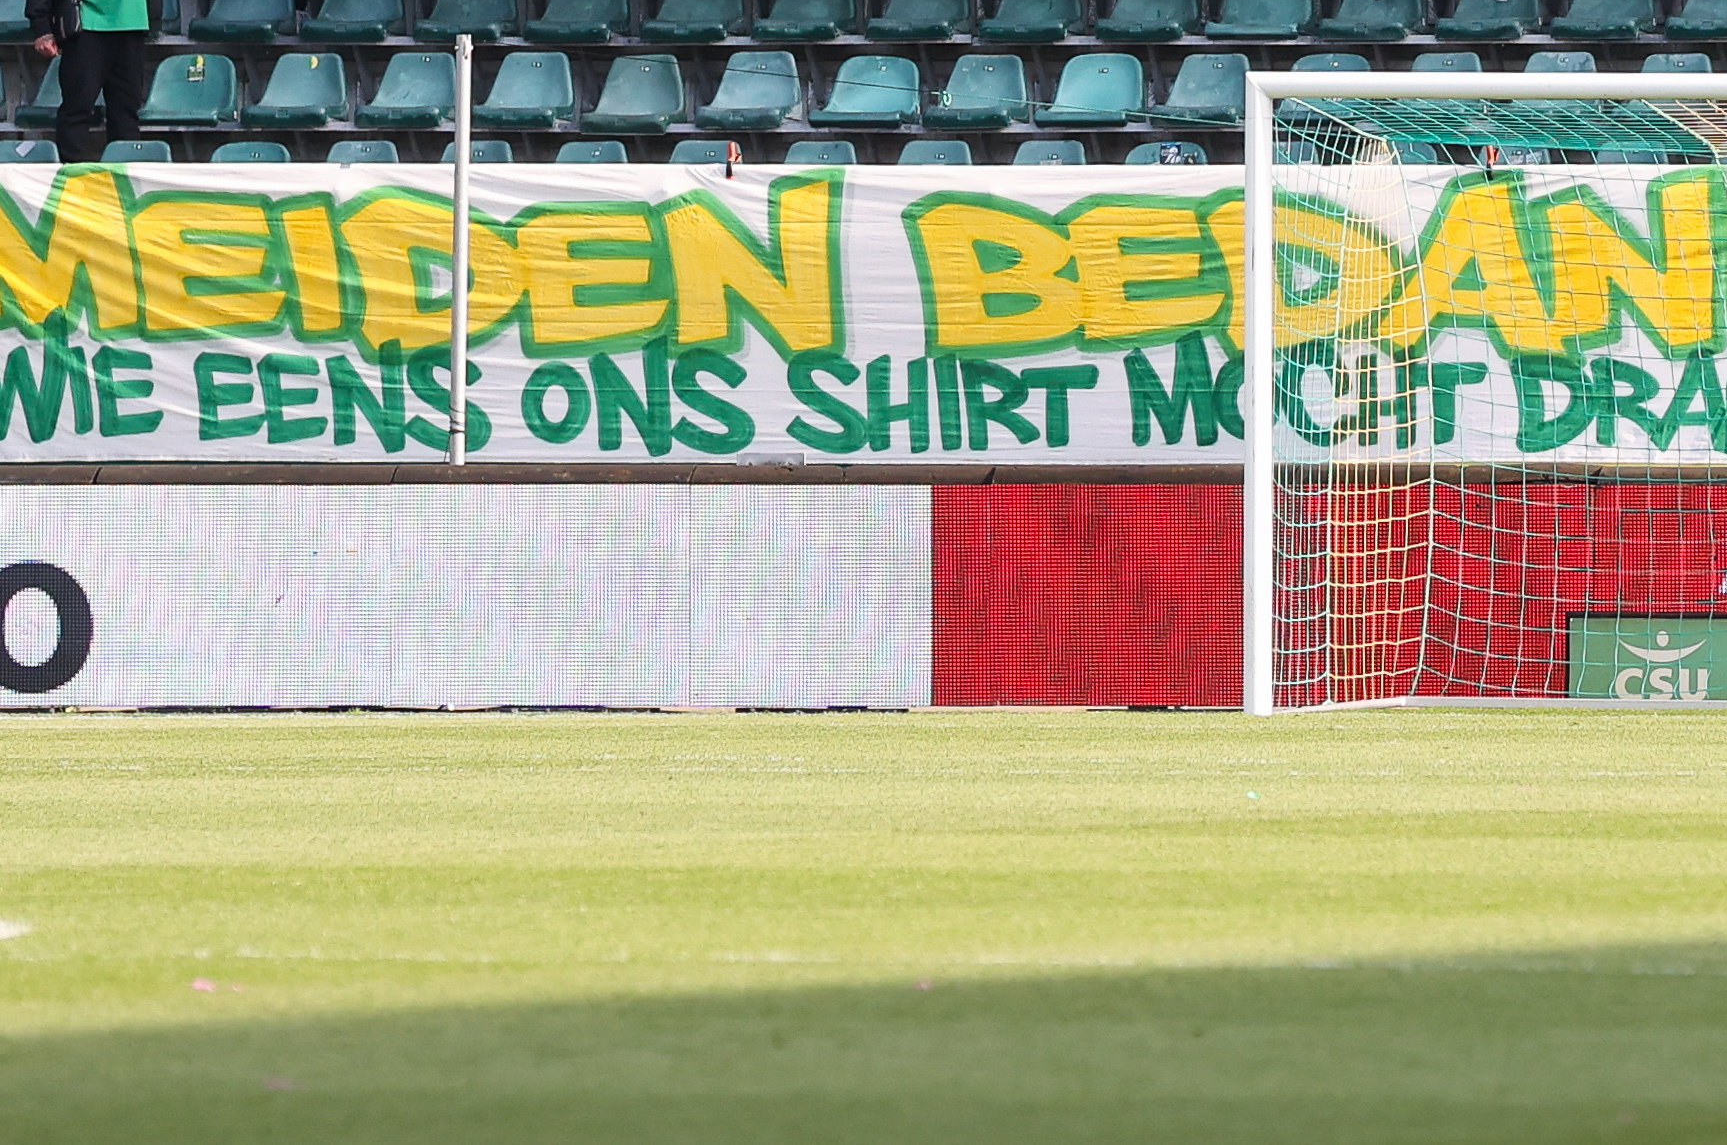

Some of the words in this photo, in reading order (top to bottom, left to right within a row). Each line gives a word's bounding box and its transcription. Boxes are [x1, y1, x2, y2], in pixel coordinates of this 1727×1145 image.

[195, 339, 492, 453] EENS
[520, 336, 755, 456] ONS
[786, 348, 1100, 454] SHIRT
